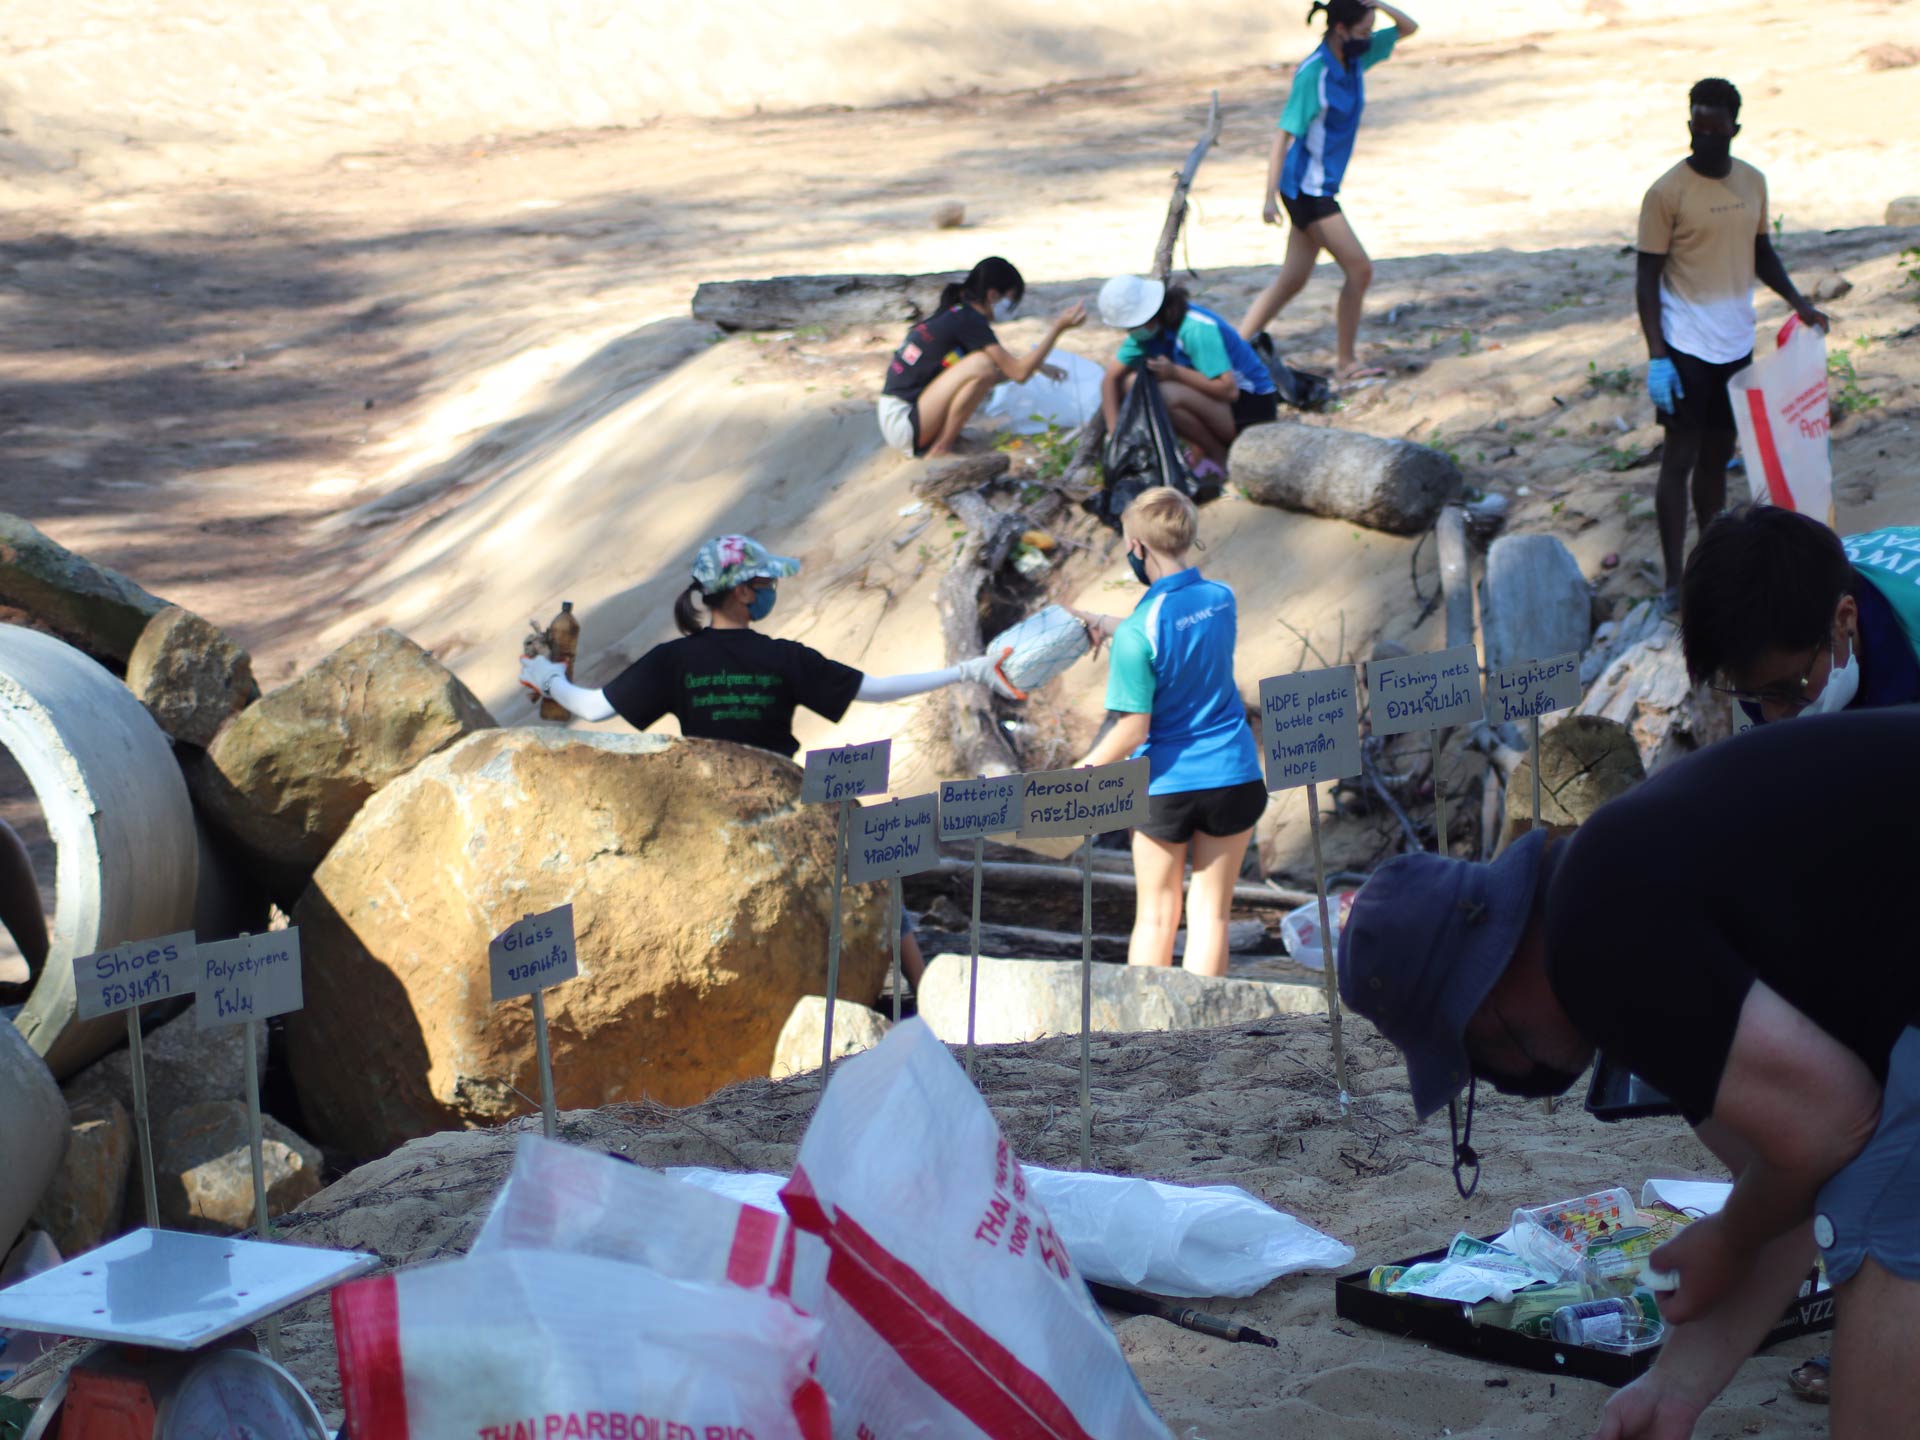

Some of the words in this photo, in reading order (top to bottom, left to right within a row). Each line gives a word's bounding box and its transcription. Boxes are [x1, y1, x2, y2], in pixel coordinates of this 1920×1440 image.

[1379, 670, 1438, 693] Fishing
[1442, 662, 1470, 678] nets
[1499, 659, 1576, 695] Lighters
[1266, 692, 1301, 714] HDPE
[1307, 687, 1348, 713] plastic
[1386, 683, 1471, 719] อวนจับปลา
[1499, 690, 1556, 721] ไฟแช็ค
[1275, 713, 1313, 733] bottle
[1318, 707, 1344, 724] caps
[828, 747, 875, 767] Metal
[1271, 732, 1336, 761] ฝาพลาสติก
[1284, 761, 1317, 777] HDPE
[823, 774, 866, 800] โลหะ
[943, 783, 1014, 803] Batteries
[1025, 779, 1089, 798] Aerosol
[1098, 776, 1125, 791] cans
[864, 815, 901, 842] Light
[904, 812, 931, 828] bulbs
[864, 835, 921, 865] หลอดไฟ
[503, 926, 554, 952] Glass
[96, 944, 179, 979] Shoes
[205, 948, 290, 982] Polystyrene
[507, 945, 568, 981] ขวดแก้ว
[102, 969, 171, 1008] รองเท้า
[214, 986, 254, 1017] โฟม
[974, 1190, 1012, 1247] THAI
[1008, 1209, 1031, 1258] 100%
[544, 1410, 696, 1440] PARBOILED
